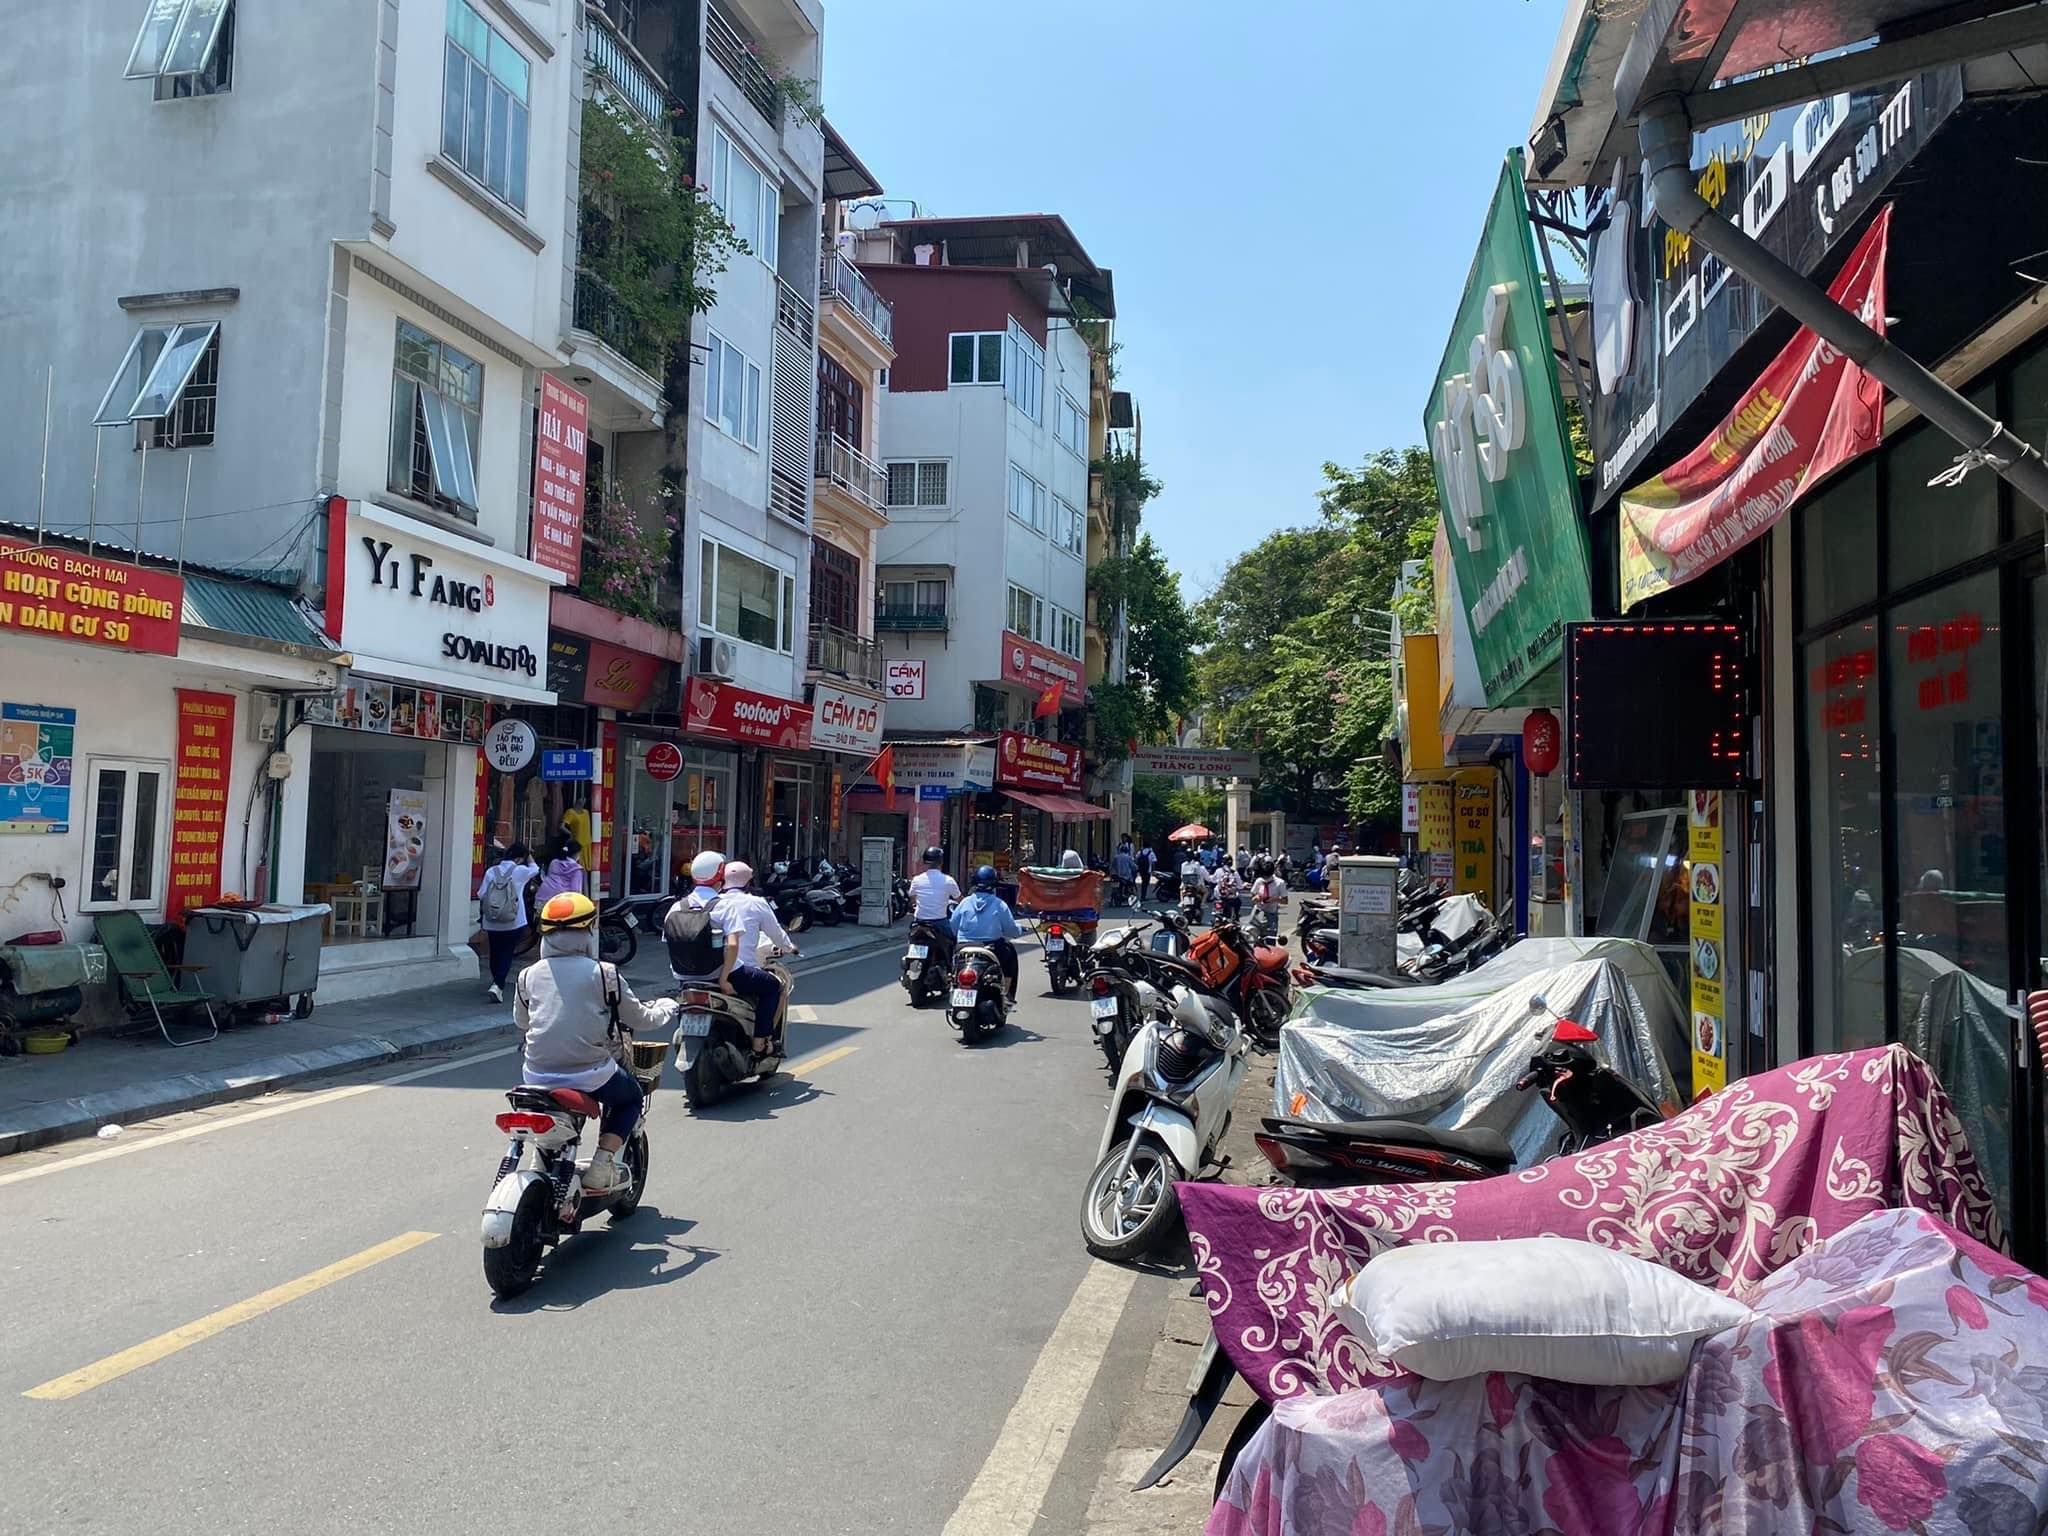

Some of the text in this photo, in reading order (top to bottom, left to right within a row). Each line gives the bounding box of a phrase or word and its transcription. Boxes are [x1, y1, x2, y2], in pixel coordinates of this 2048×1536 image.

[1727, 387, 1784, 449] MOBILE
[542, 408, 561, 443] HẢI
[564, 424, 584, 455] ANH
[64, 559, 100, 579] BẠCH
[105, 568, 127, 585] MAI
[4, 570, 173, 620] HOẠT CỘNG ĐỒNG
[20, 604, 65, 632] DÂN
[70, 614, 100, 637] CƯ
[733, 701, 781, 725] soofood
[26, 768, 43, 780] 5K
[1199, 763, 1232, 772] LONG
[1468, 819, 1481, 830] 02
[1376, 1160, 1429, 1176] Wave
